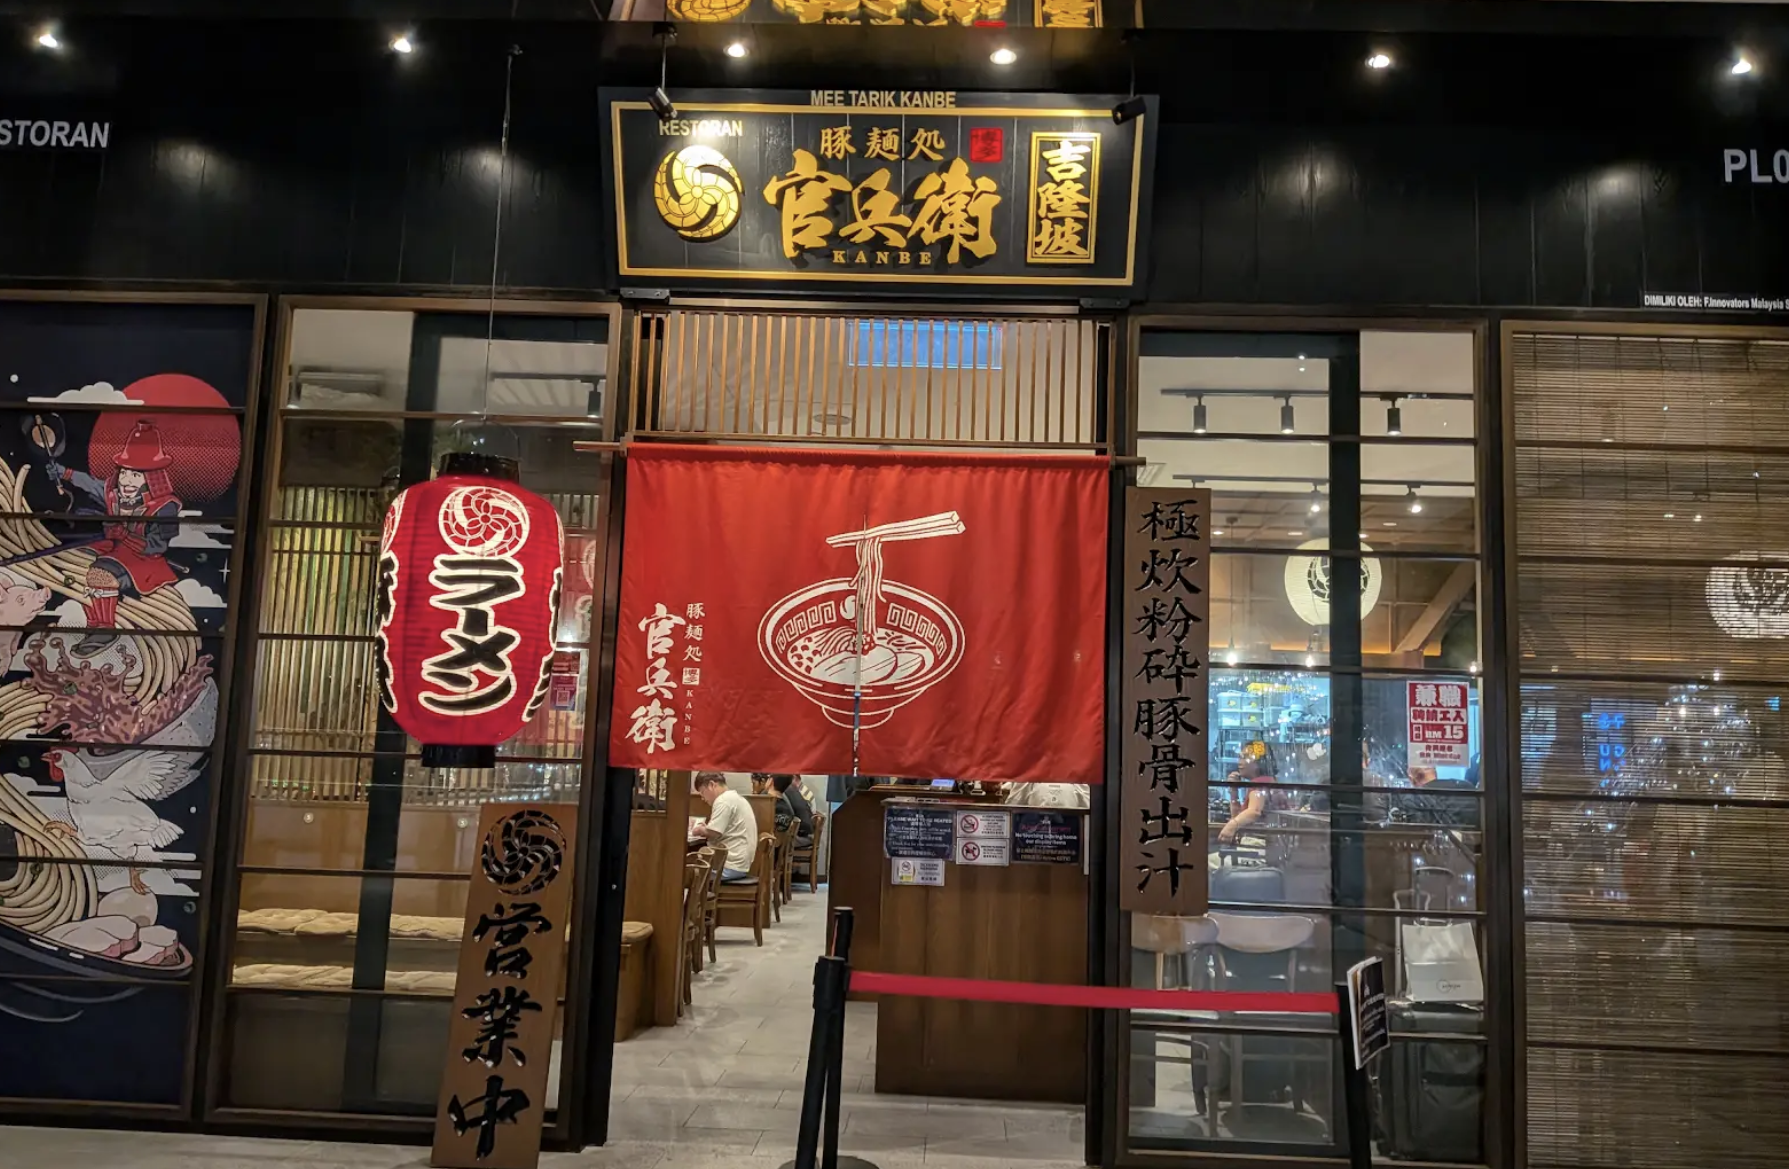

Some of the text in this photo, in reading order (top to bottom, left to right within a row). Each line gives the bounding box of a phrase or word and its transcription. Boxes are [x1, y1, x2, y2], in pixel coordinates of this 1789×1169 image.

[659, 119, 743, 136] RESTORAN
[810, 90, 956, 108] MEE TARIK KANBE
[0, 119, 110, 148] STORAN
[820, 125, 945, 161] 豚麺処
[762, 148, 1002, 264] 官兵衛
[1035, 139, 1092, 255] 吉隆坡
[832, 250, 932, 266] KANBE
[1644, 294, 1676, 307] DIMILIKI
[1677, 295, 1702, 308] OLEH:
[1750, 297, 1784, 312] Malaysia
[419, 554, 525, 716] ラーメン
[682, 602, 705, 663] 豚麺処
[625, 602, 687, 755] 官兵衛
[1133, 499, 1203, 899] 極炊粉砕豚骨出汁
[683, 689, 694, 746] KANBE
[1443, 725, 1464, 739] 15
[448, 902, 552, 1160] 営業中
